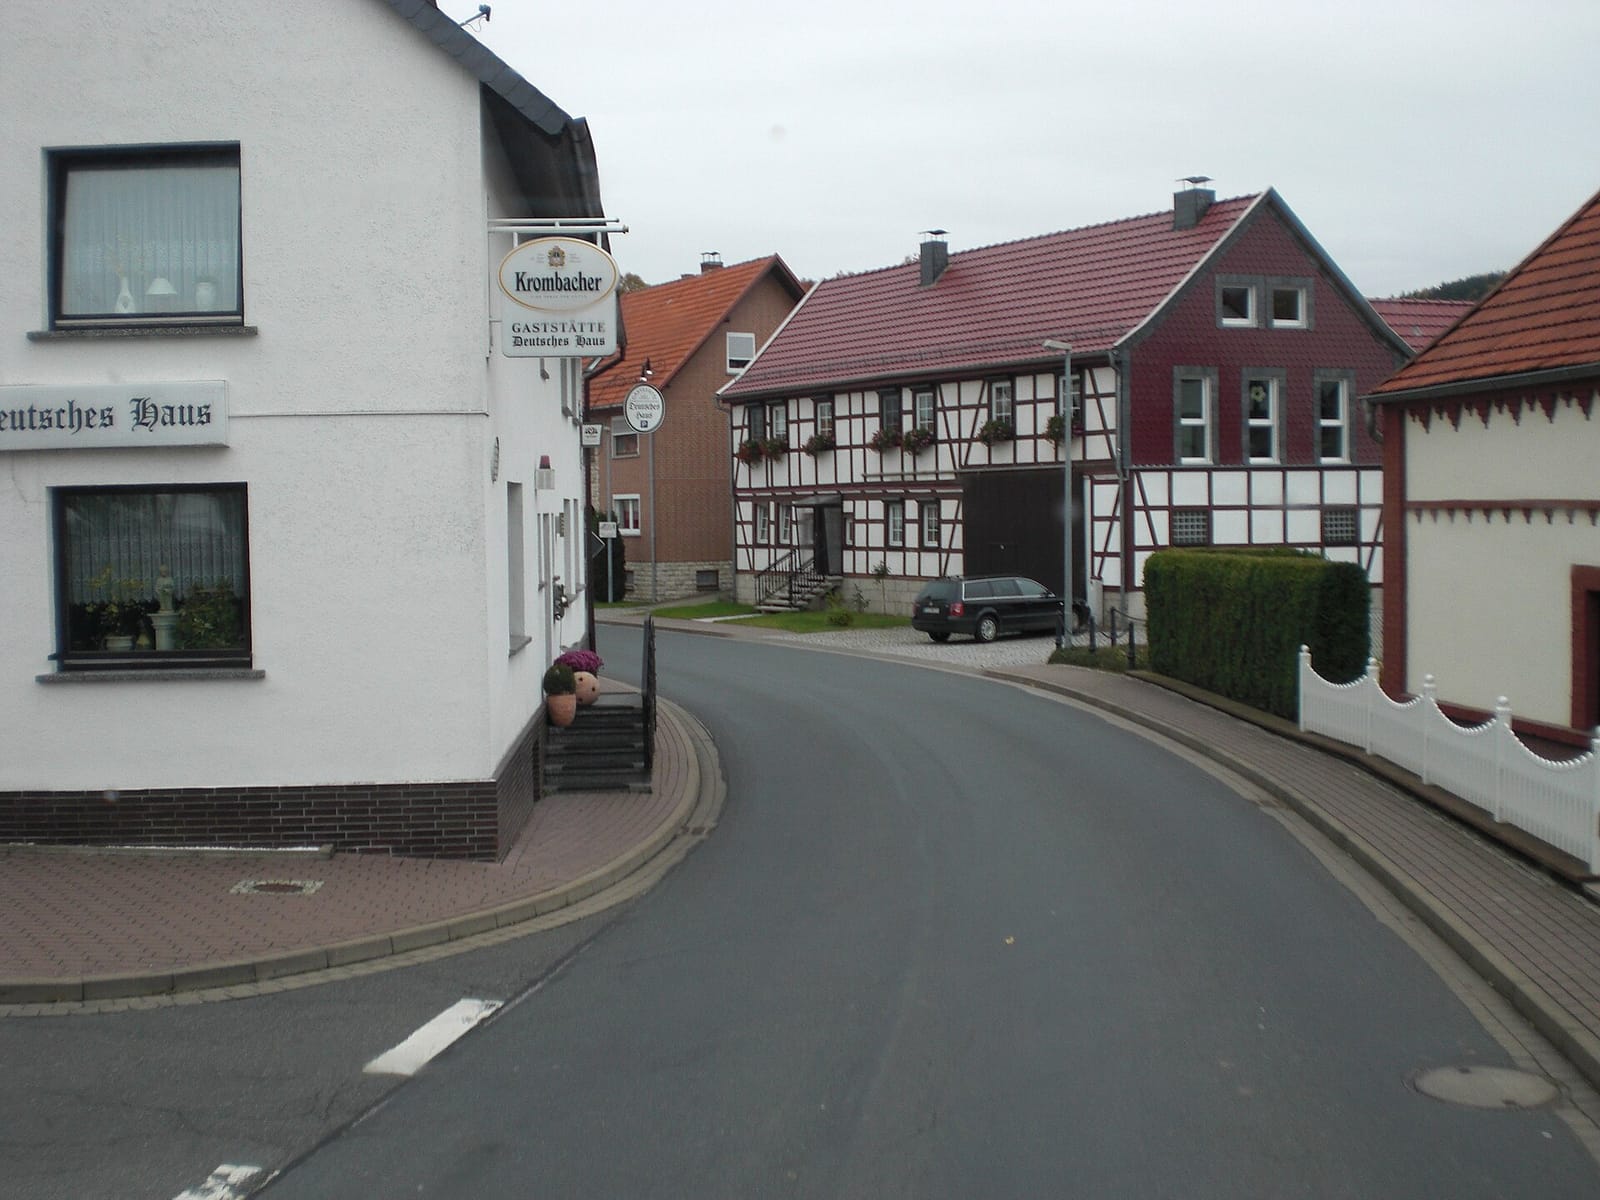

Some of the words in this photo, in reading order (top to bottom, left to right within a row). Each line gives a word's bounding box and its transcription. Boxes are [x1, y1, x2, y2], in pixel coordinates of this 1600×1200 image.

[514, 271, 602, 292] Krombacher
[512, 319, 605, 333] GASTSTÄTTE
[512, 335, 569, 348] Deutsches
[575, 335, 605, 348] Haus
[130, 397, 212, 432] Haus
